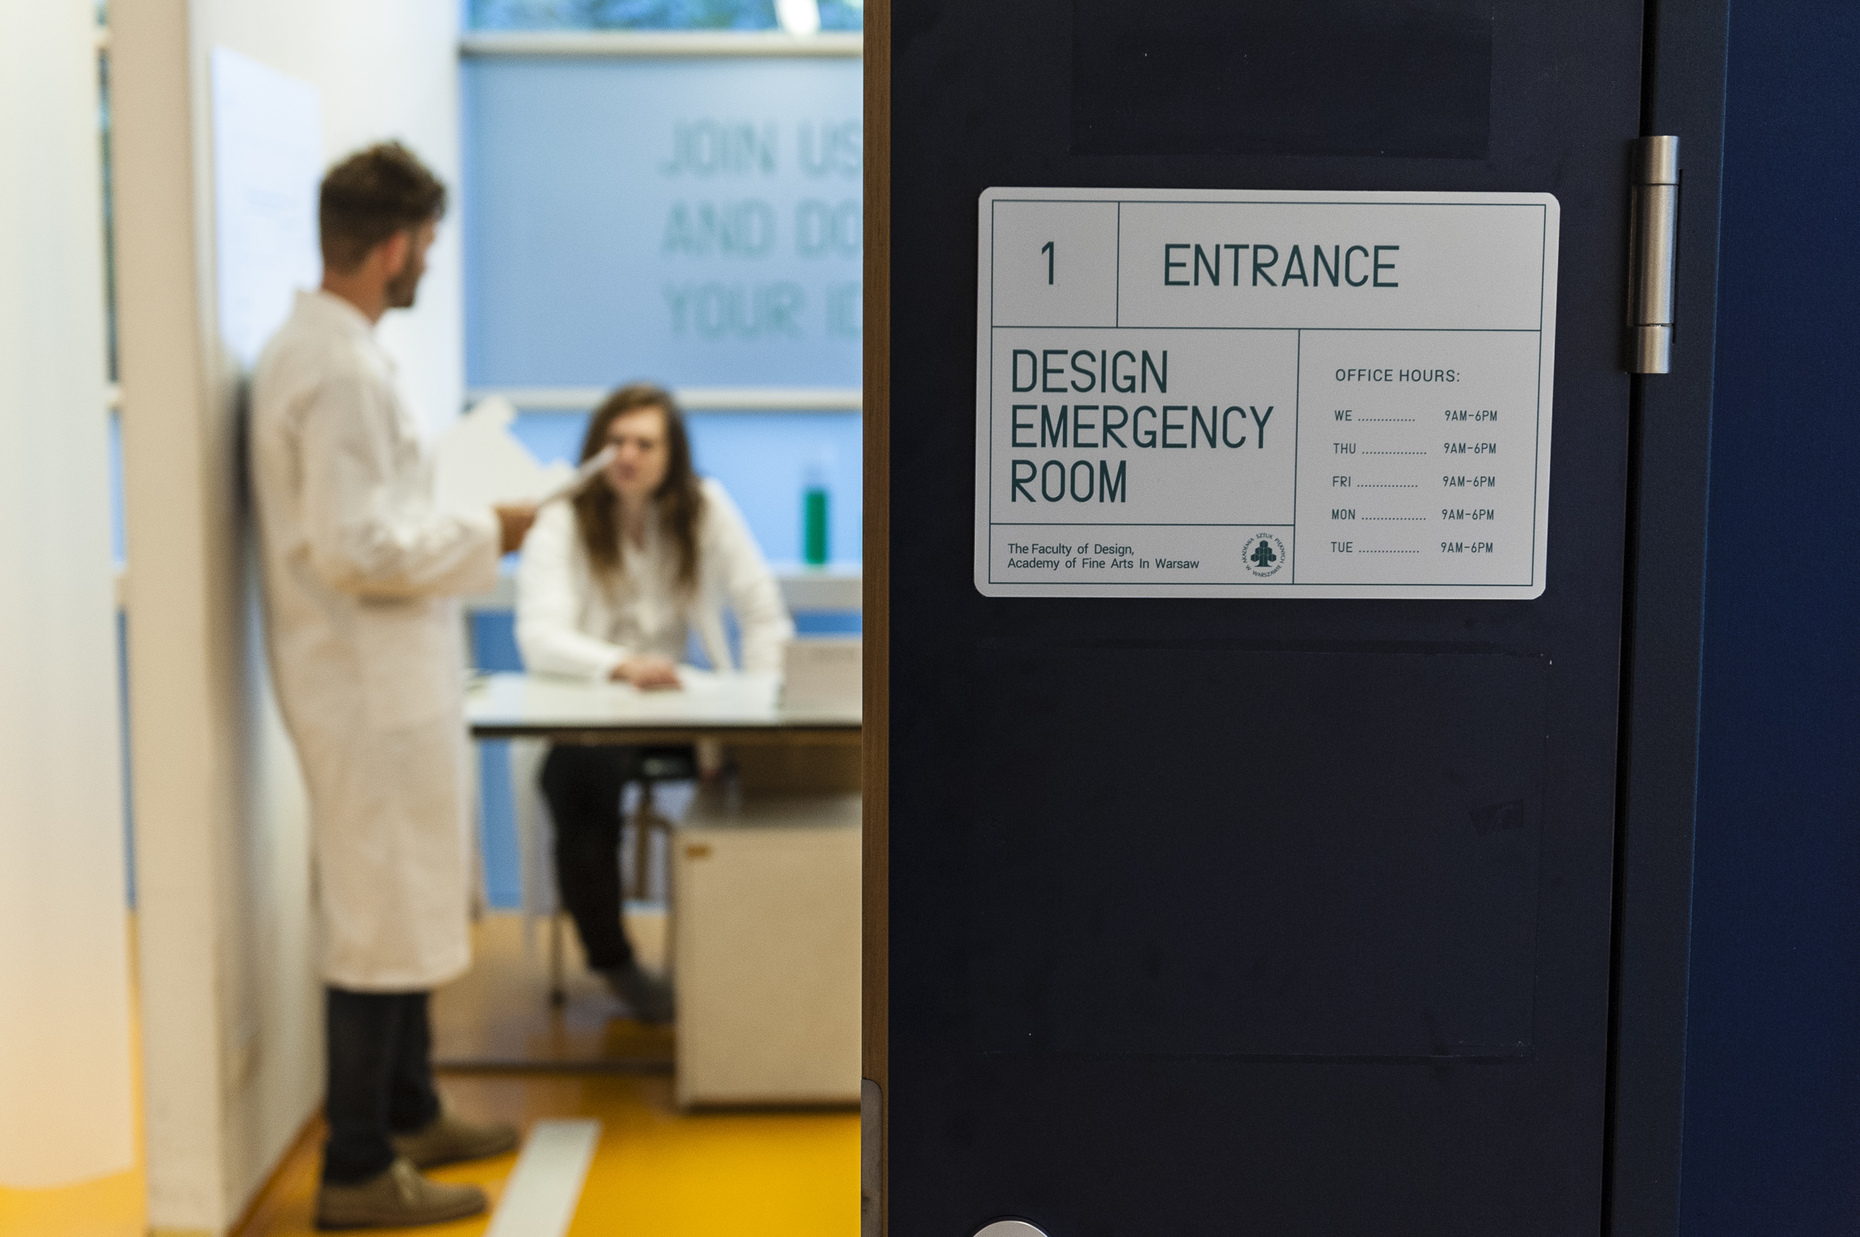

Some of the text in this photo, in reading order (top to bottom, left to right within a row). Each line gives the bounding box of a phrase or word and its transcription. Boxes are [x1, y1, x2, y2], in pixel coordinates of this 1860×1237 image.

[659, 119, 776, 177] JOIN
[661, 199, 775, 258] AND
[1041, 241, 1055, 286] 1
[1163, 243, 1400, 288] ENTRANCE
[661, 281, 805, 339] YOUR
[1011, 348, 1168, 394] DESIGN
[1335, 368, 1461, 383] OFFICE HOURS:
[1011, 404, 1275, 450] EMERGENCY
[1333, 409, 1498, 422] WE 9AM-6PM
[1333, 442, 1497, 455] THU 9AM-6PM
[1010, 458, 1127, 504] ROOM
[1332, 475, 1496, 488] FRI 9AM-6PM
[1331, 508, 1495, 521] MON 9AM-6PM
[1007, 543, 1135, 557] The Faculty of Design,
[1331, 541, 1494, 554] TUE 9AM-6PM
[1007, 557, 1200, 571] Academy of Fine Arts In Warsaw
